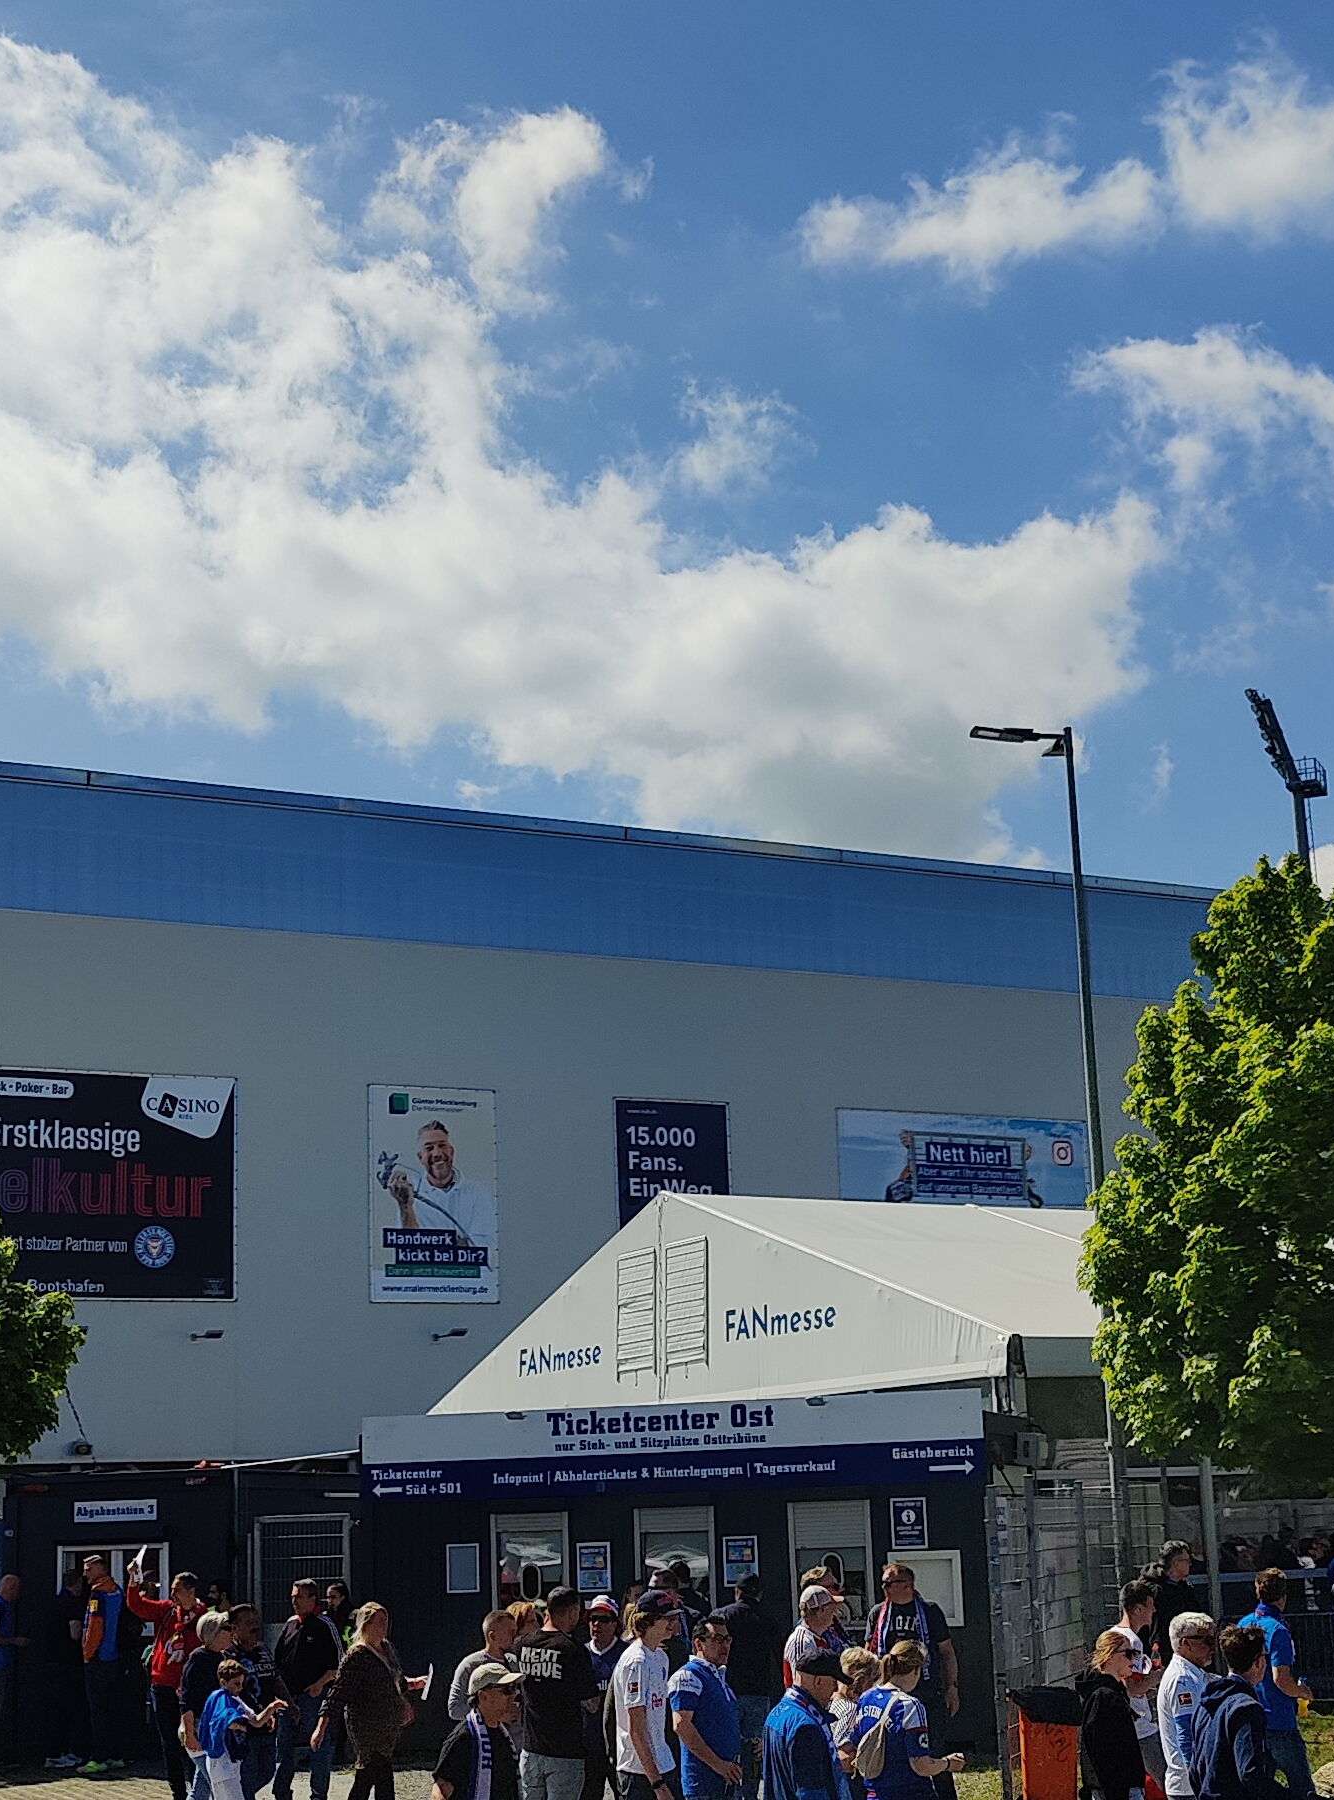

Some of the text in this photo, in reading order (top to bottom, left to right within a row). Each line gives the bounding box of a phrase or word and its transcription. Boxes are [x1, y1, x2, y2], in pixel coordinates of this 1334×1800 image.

[16, 1081, 44, 1094] Poker
[52, 1083, 69, 1095] Bar
[146, 1097, 220, 1114] CASINO
[626, 1126, 696, 1147] 15.000
[628, 1151, 684, 1172] Fans.
[929, 1144, 1007, 1165] Nett hier!
[917, 1166, 938, 1176] Aber
[629, 1177, 662, 1197] Ein
[27, 1236, 63, 1251] stolzer
[66, 1236, 106, 1252] Partner
[108, 1240, 128, 1253] von
[387, 1231, 453, 1245] Handwerk
[398, 1248, 485, 1263] kickt bei Dir?
[27, 1279, 105, 1293] Bootshafen
[725, 1304, 836, 1342] FANmesse
[519, 1344, 602, 1377] FANmesse
[546, 1403, 774, 1436] Ticketcenter Ost
[554, 1432, 766, 1452] nur Steh- und Sitzplätze Osttribüne
[892, 1445, 974, 1460] Gästebereich
[371, 1469, 443, 1481] Ticketcenter
[493, 1472, 544, 1486] Infopoint
[553, 1468, 638, 1482] Abholertickets
[653, 1464, 744, 1479] Hinterlegungen
[754, 1459, 836, 1476] Tagesverkauf
[76, 1504, 154, 1518] Abgabestation 3
[519, 1661, 563, 1679] WAVE
